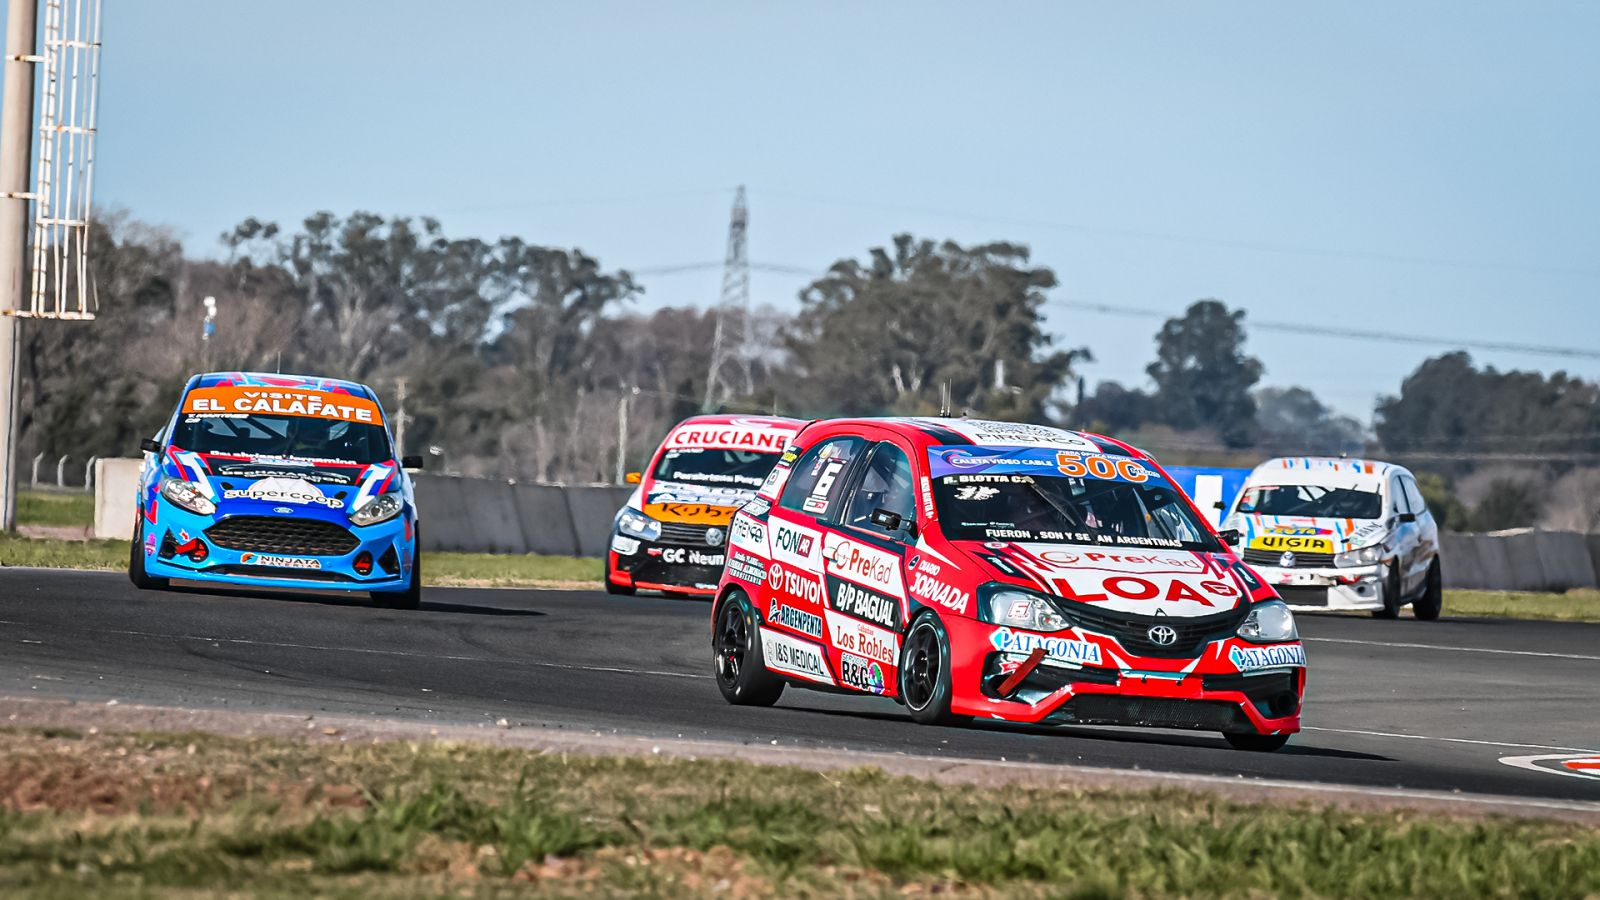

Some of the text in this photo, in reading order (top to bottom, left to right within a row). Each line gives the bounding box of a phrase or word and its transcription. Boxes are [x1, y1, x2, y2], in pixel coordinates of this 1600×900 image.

[244, 391, 322, 402] VISITE
[193, 398, 372, 421] EL CALAFATE
[1021, 459, 1054, 467] CABLE
[959, 475, 1009, 483] BLOTTA
[226, 488, 343, 507] supercoop
[985, 529, 1030, 540] FUERON
[1040, 531, 1062, 540] SON
[1063, 532, 1073, 540] Y
[1116, 536, 1183, 548] ARGENTINAS
[261, 555, 320, 564] NINJATA
[663, 548, 685, 563] GC
[848, 548, 893, 584] PreKad
[1084, 552, 1204, 569] PreKad
[910, 572, 969, 614] JORNADA
[855, 591, 894, 627] BAGUAL
[780, 604, 822, 637] ARGENPENTA
[837, 625, 893, 663] Los Robles
[1002, 629, 1100, 662] PATAGONIA
[789, 646, 824, 674] MEDICAL
[1236, 646, 1305, 668] PATAGONIA
[842, 660, 868, 689] R&G
